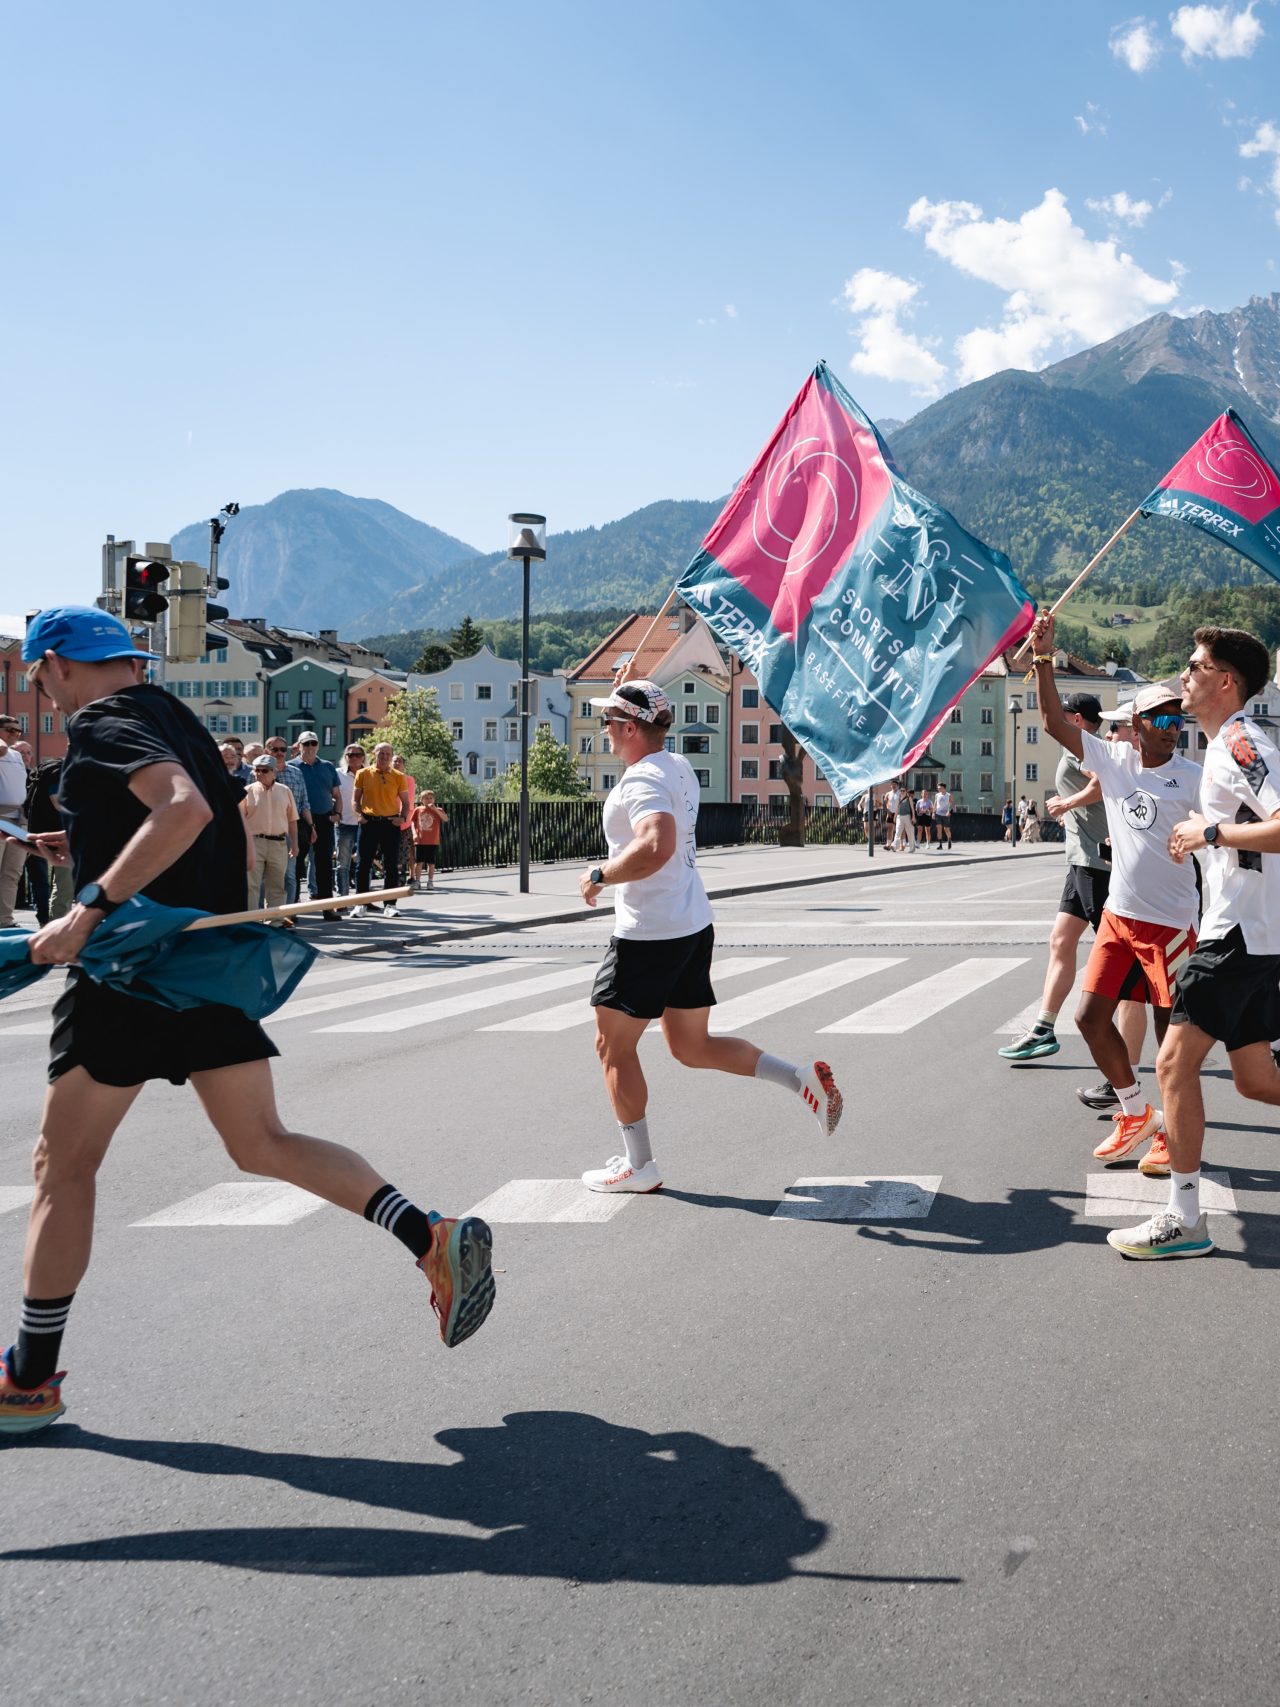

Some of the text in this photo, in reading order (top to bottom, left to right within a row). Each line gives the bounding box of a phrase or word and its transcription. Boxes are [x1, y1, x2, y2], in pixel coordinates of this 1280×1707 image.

[1181, 501, 1244, 538] TERREX
[841, 589, 904, 655] SPORTS
[830, 608, 922, 710] COMMUNITY
[1149, 1227, 1183, 1246] HOKA
